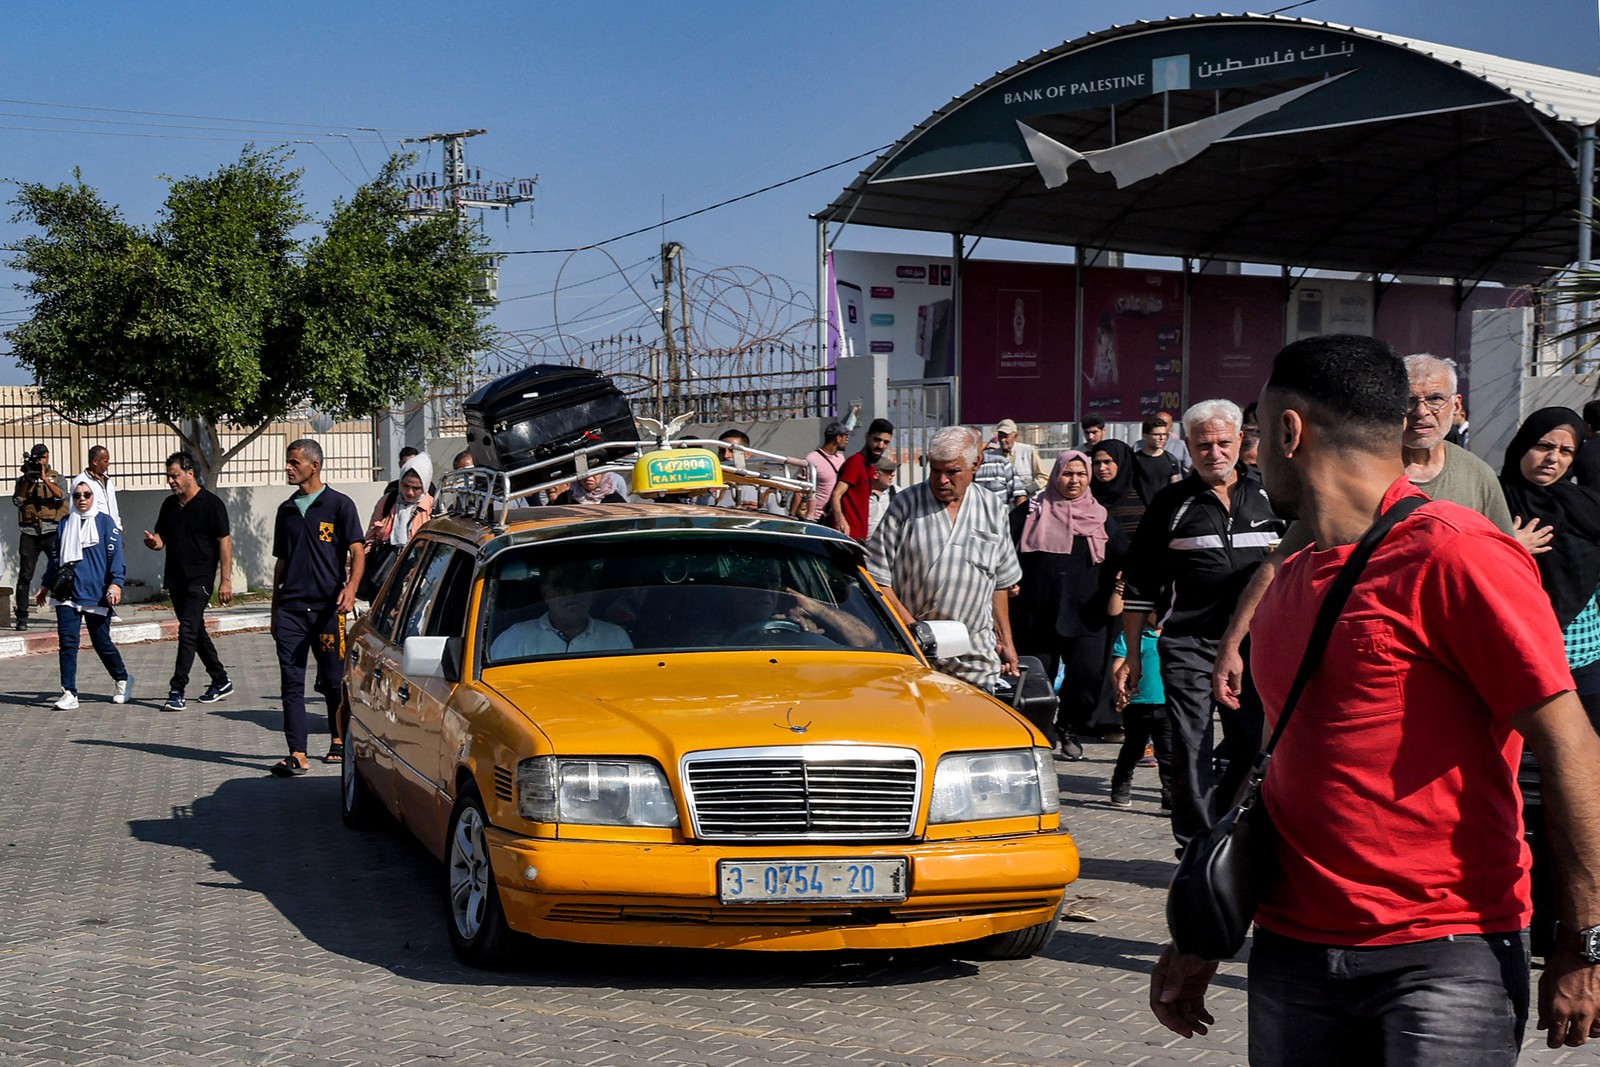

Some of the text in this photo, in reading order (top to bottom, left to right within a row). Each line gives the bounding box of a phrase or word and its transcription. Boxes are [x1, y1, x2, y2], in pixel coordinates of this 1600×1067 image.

[1198, 49, 1295, 78] فلسطين
[1004, 73, 1146, 105] BANK OF PALESTINE
[1159, 391, 1181, 409] 700
